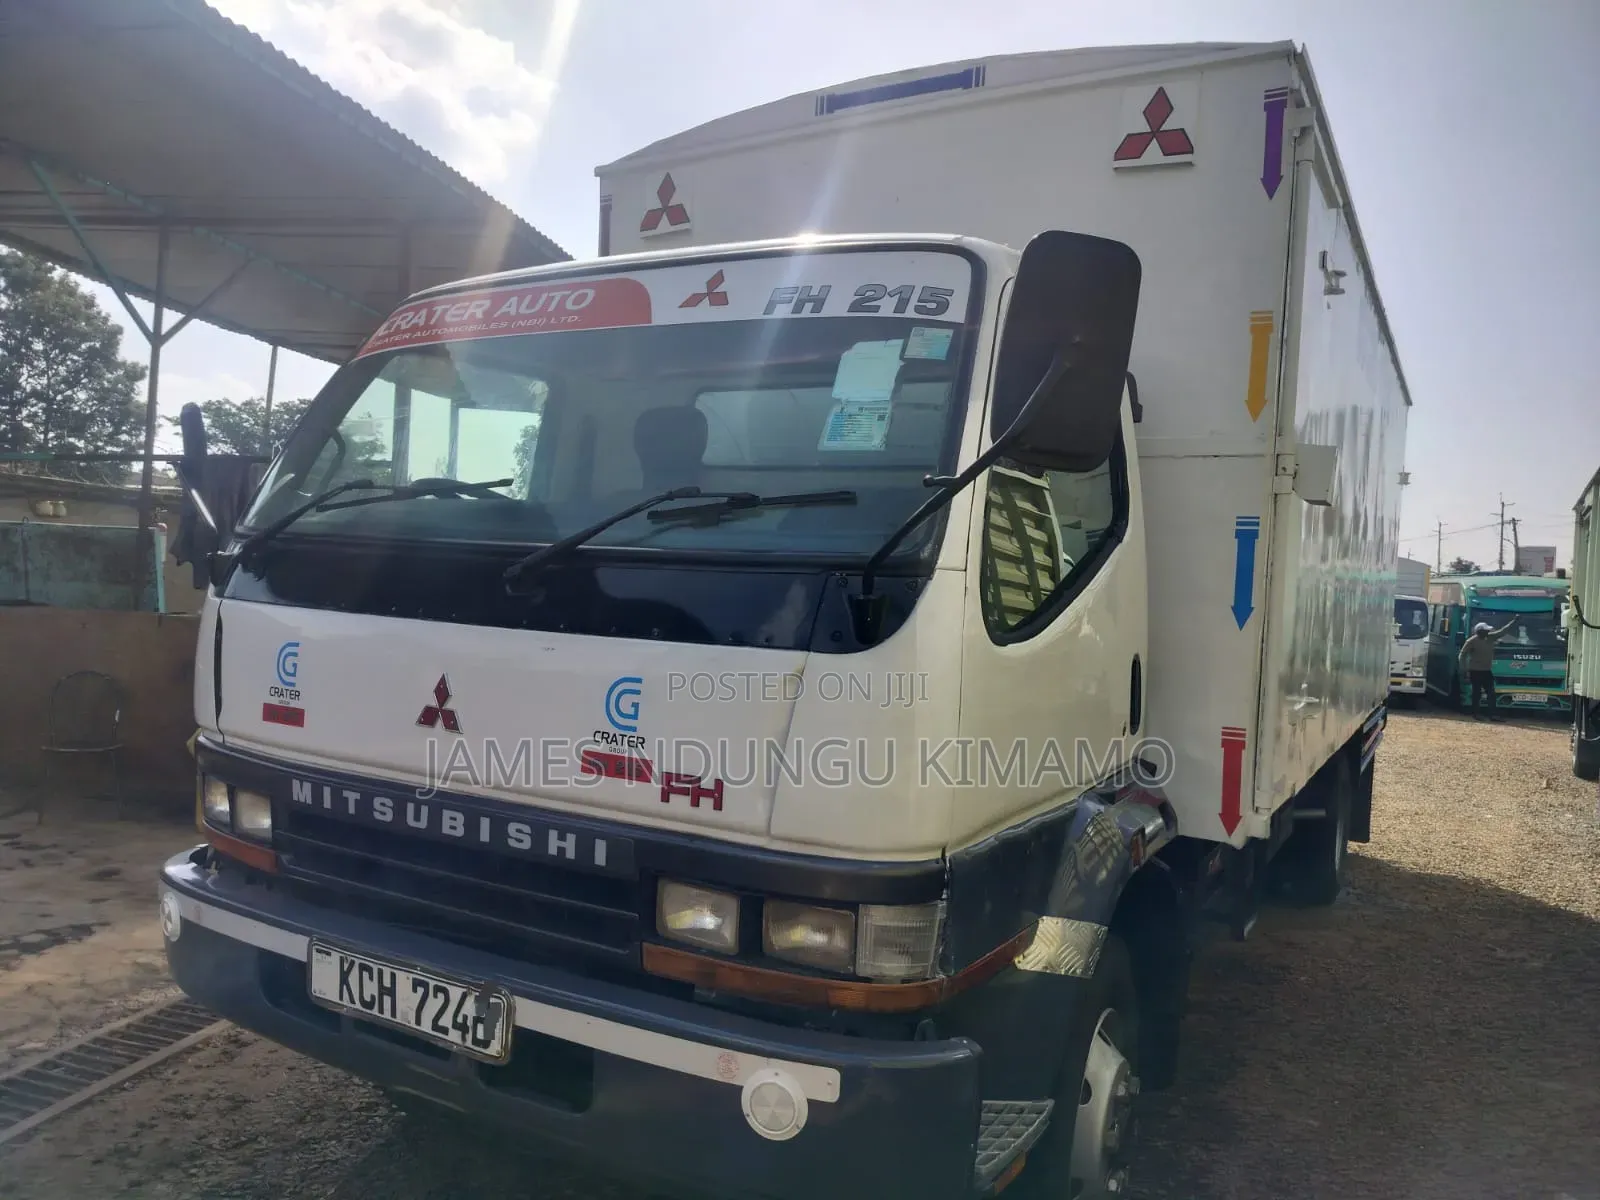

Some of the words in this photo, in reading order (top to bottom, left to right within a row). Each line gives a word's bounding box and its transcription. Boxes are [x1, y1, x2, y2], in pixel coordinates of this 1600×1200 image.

[377, 299, 491, 337] CRATER
[494, 288, 596, 318] AUTO
[762, 284, 832, 316] FH
[846, 283, 955, 317] 215
[412, 321, 509, 338] AUTOMOBILES
[511, 316, 547, 329] (NBI)
[549, 315, 583, 324] LTD.
[269, 686, 301, 701] CRATER
[593, 730, 646, 750] CRATER
[660, 771, 724, 811] FH
[292, 779, 607, 867] MITSUBISHI
[338, 955, 397, 1019] KCH
